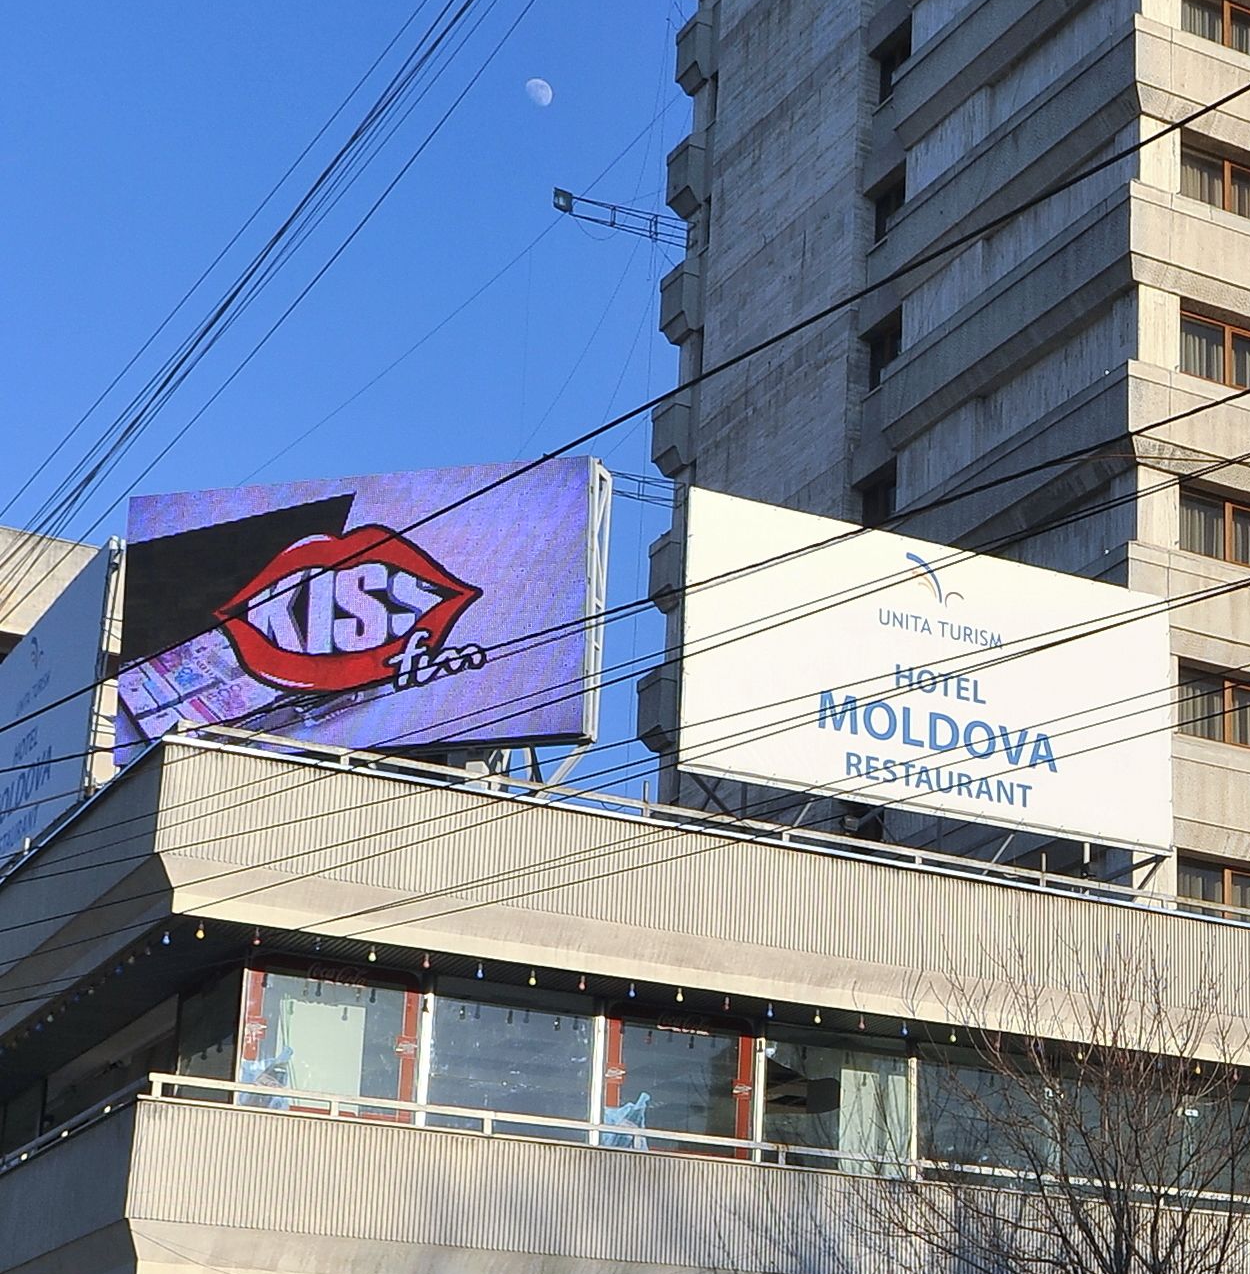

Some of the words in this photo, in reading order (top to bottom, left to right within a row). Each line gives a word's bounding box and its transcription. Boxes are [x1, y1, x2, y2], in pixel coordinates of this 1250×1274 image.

[247, 563, 444, 655] KISS
[879, 608, 933, 635] UNITA
[937, 620, 1004, 650] TURISM
[894, 663, 987, 705] HOTEL
[817, 690, 1058, 774] MOLDOVA
[0, 745, 53, 825] OLDOVA
[845, 751, 1033, 809] RESTAURANT
